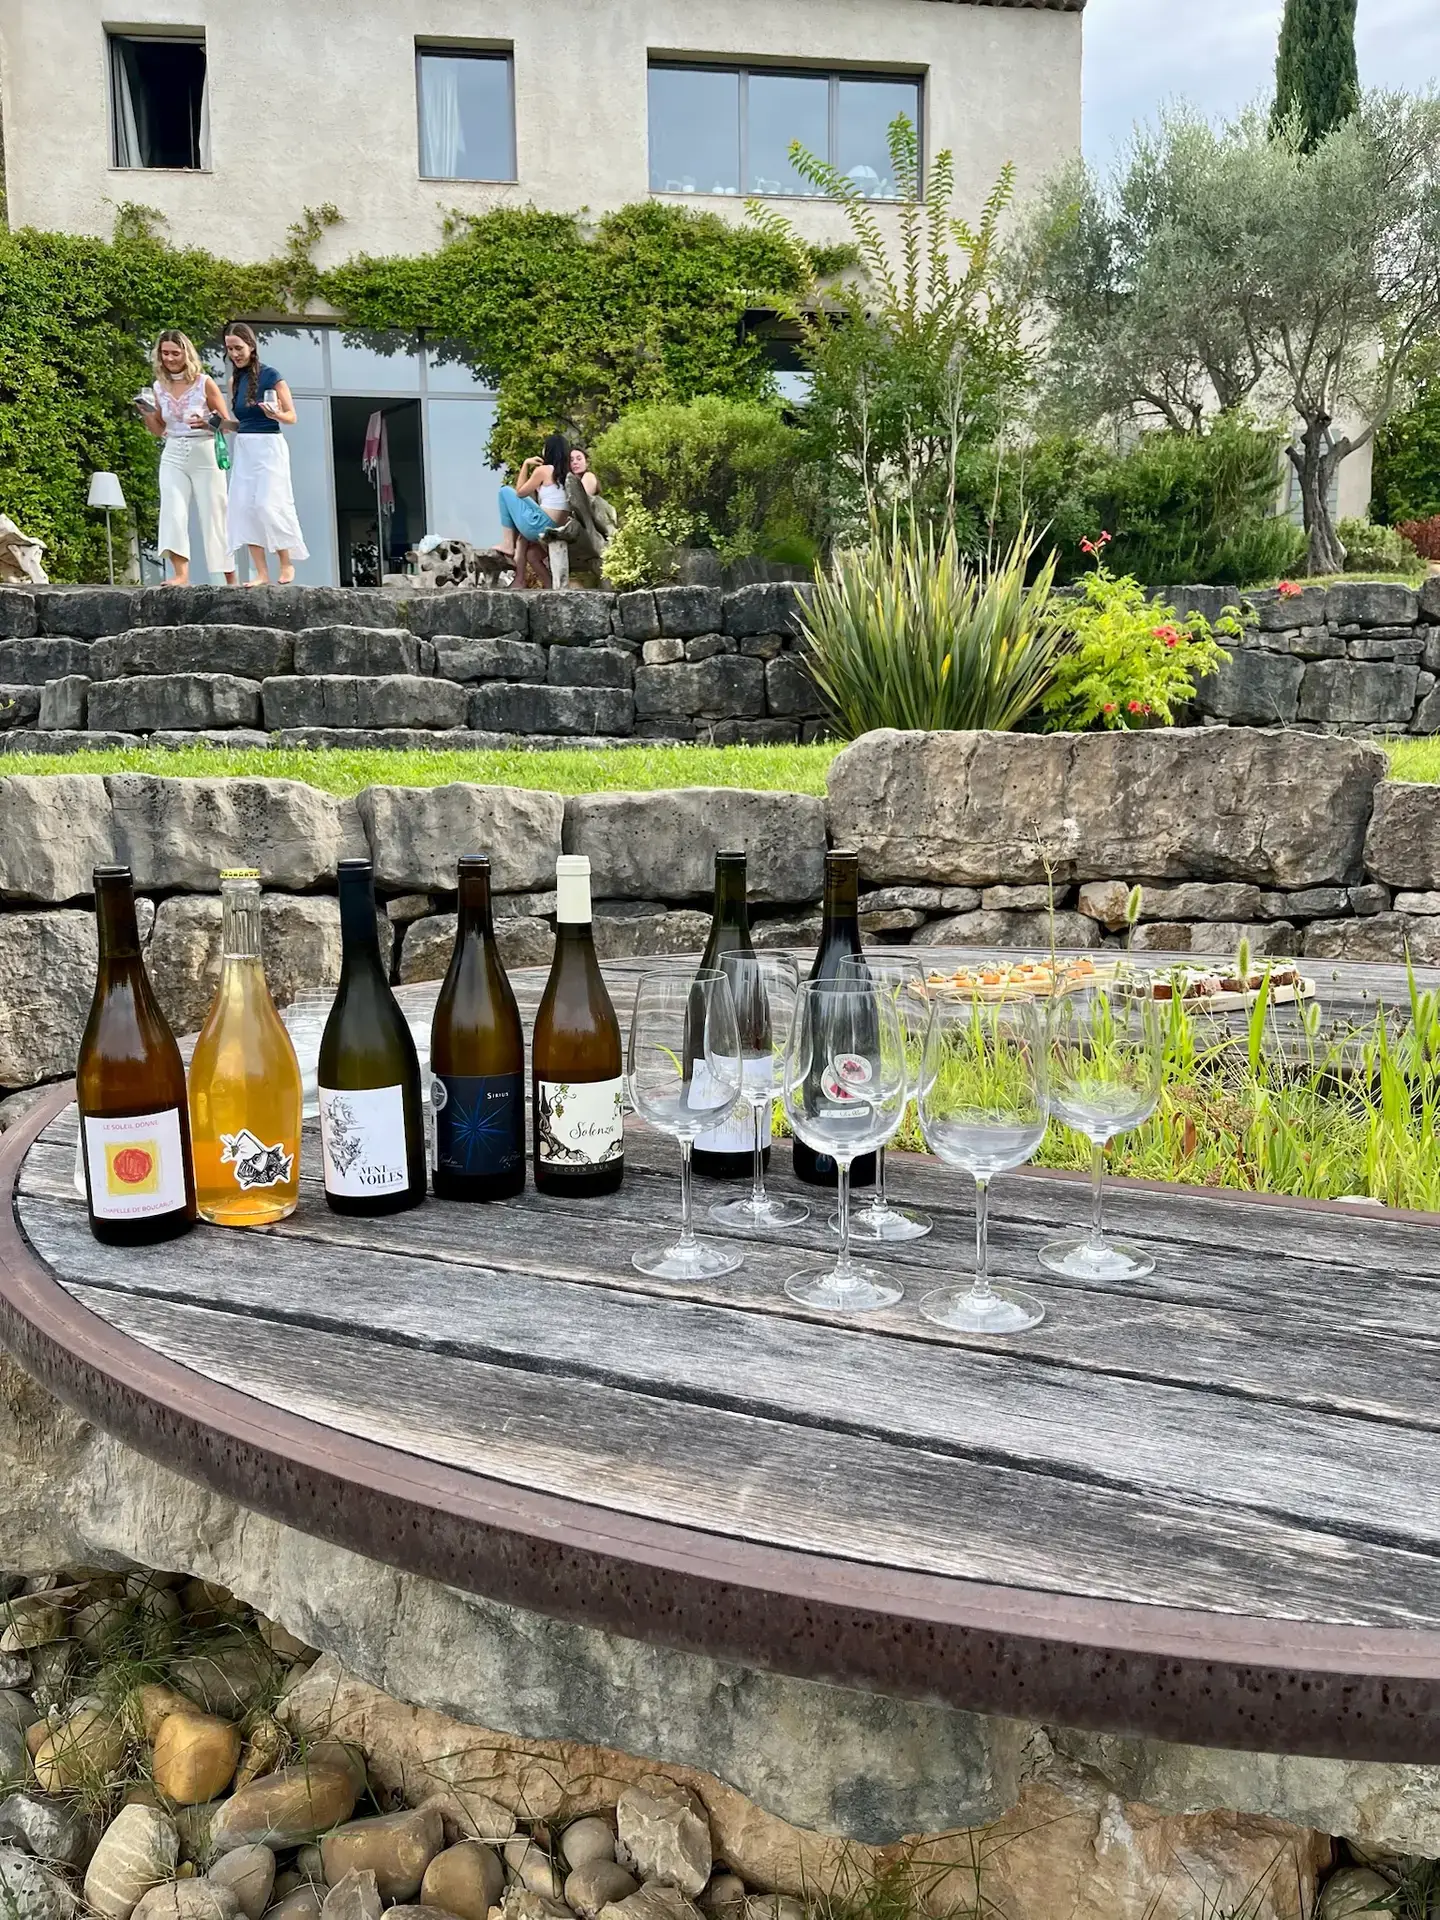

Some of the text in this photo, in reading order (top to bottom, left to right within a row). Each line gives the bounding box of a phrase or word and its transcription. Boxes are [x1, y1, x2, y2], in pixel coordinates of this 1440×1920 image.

[135, 1120, 158, 1128] DONNE
[569, 1121, 614, 1140] Solenza
[360, 1164, 387, 1175] VENT
[358, 1169, 404, 1186] VOILES
